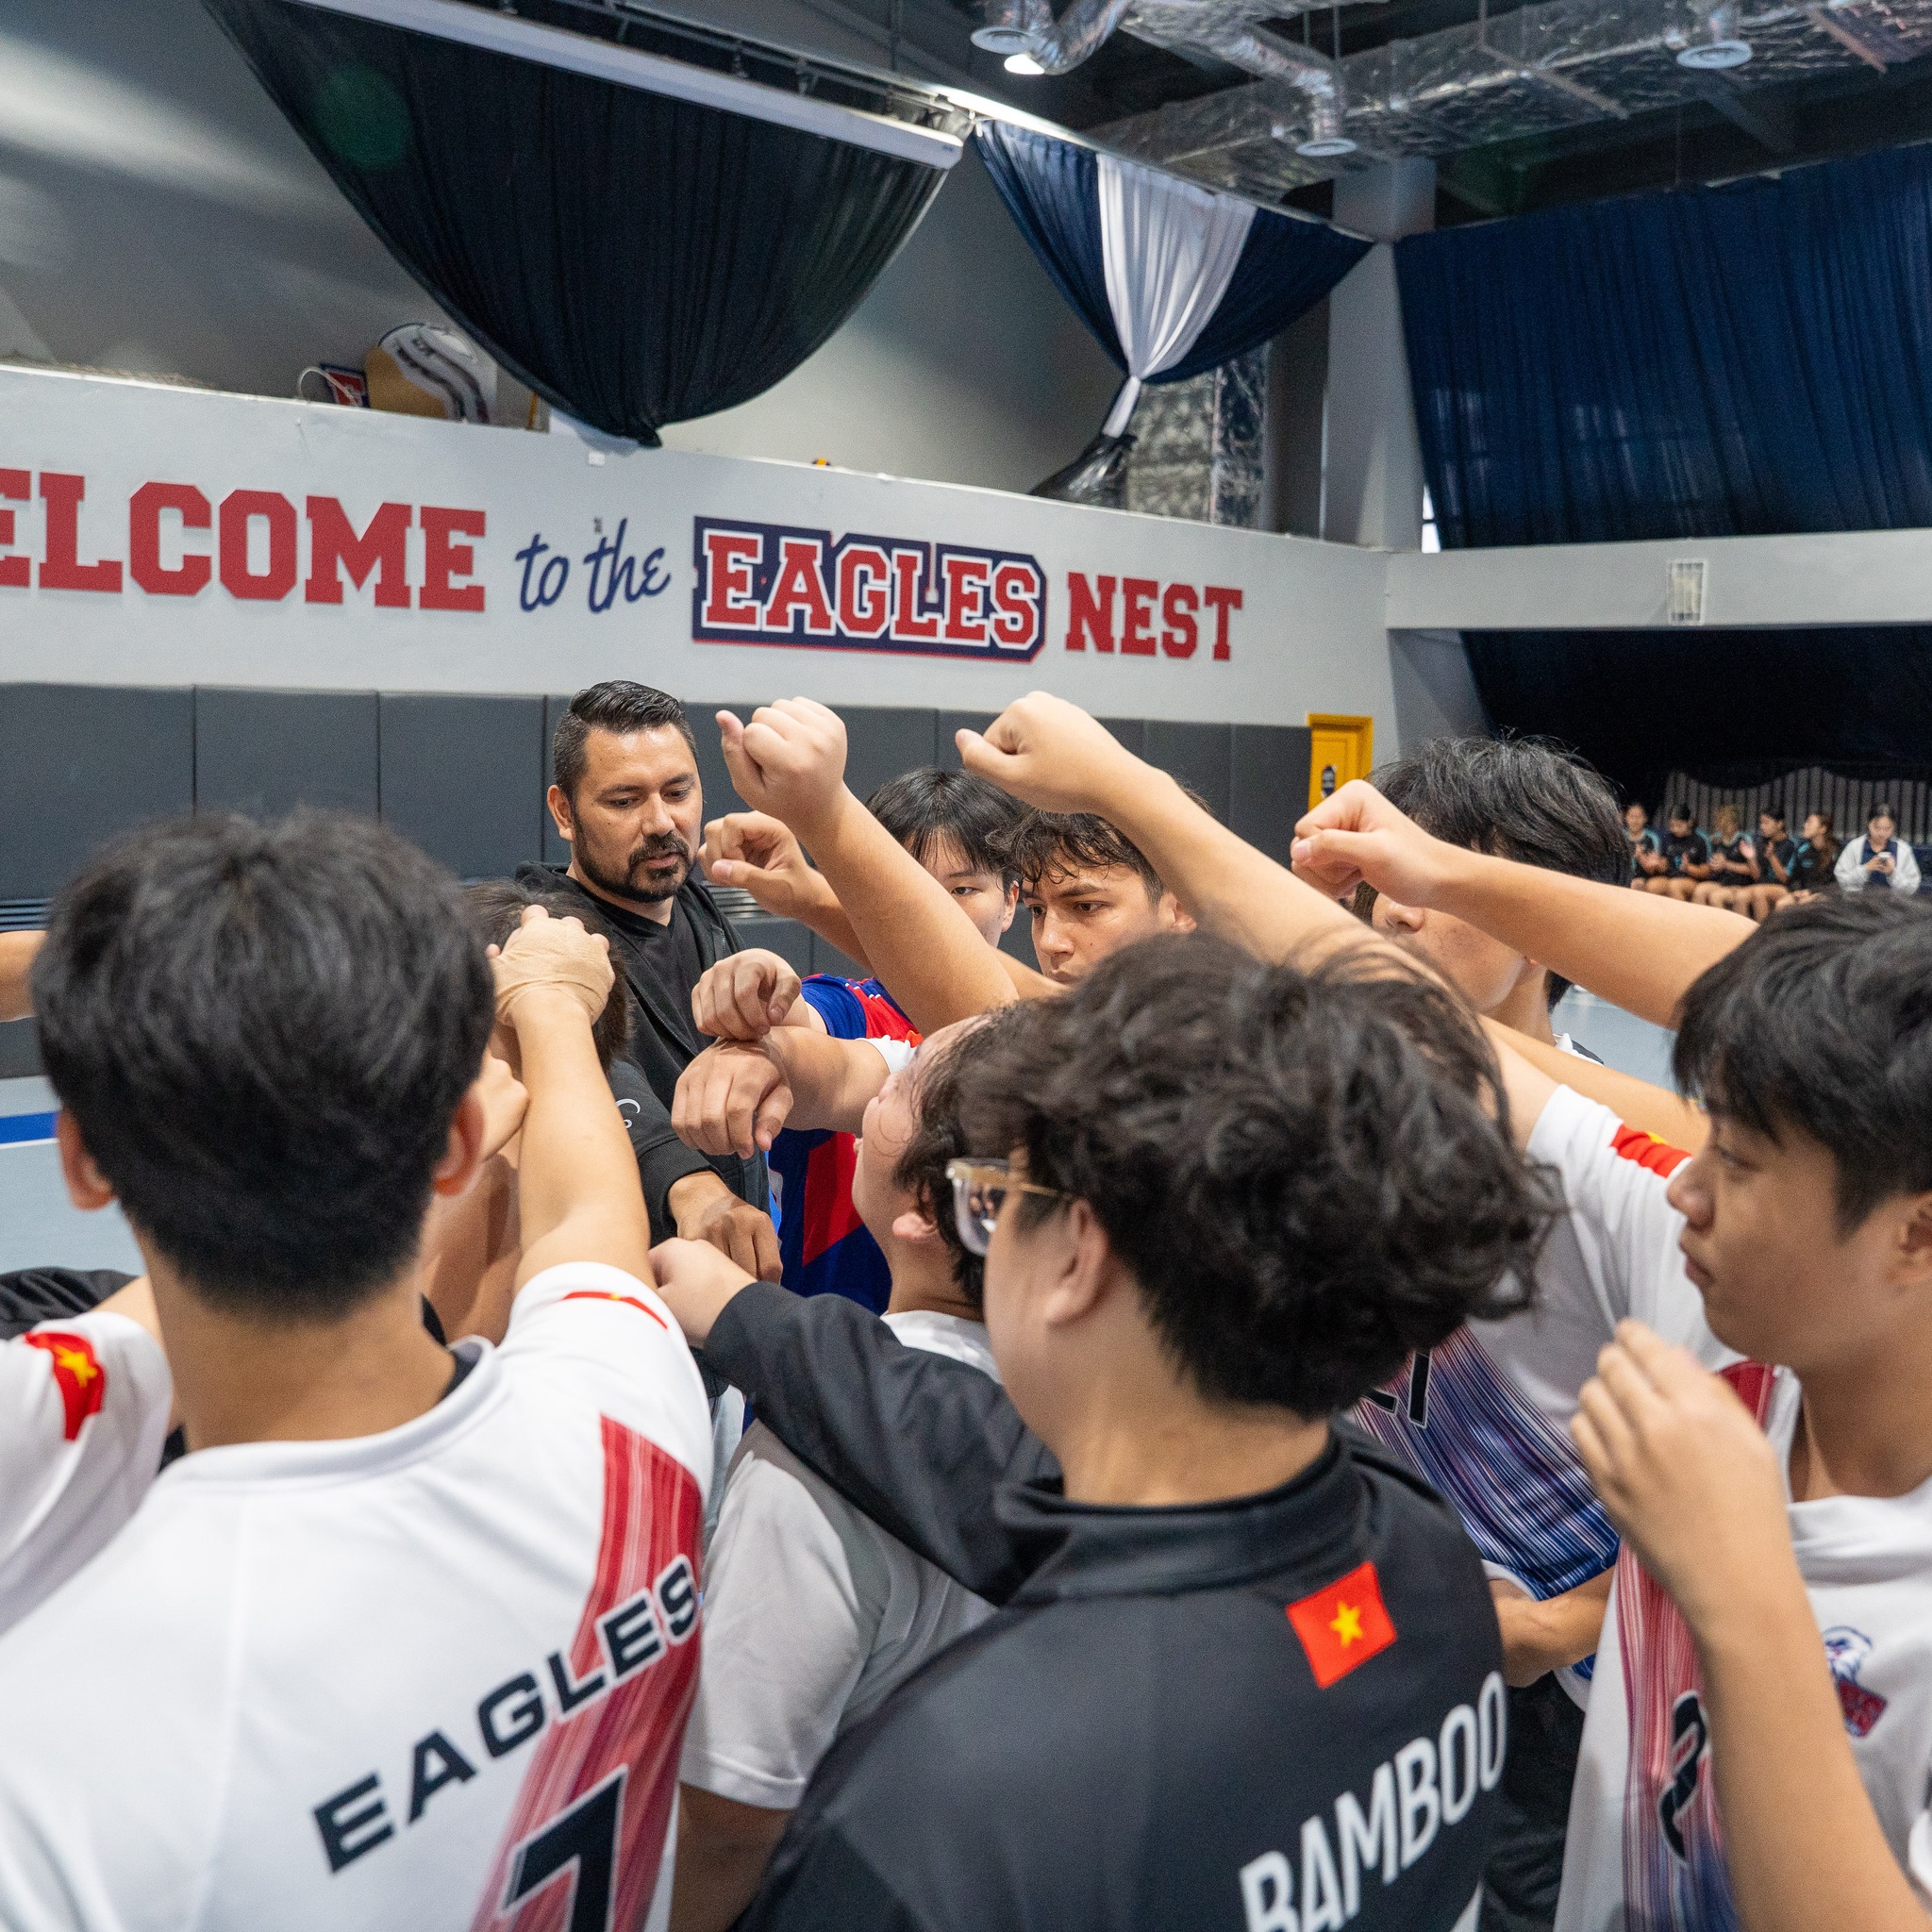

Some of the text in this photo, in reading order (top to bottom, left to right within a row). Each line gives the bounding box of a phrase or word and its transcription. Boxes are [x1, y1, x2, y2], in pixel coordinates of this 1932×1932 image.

[515, 533, 570, 612] to
[583, 518, 672, 614] the
[701, 528, 1042, 651] EAGLES
[1065, 571, 1243, 660] NEST
[312, 1555, 700, 1875] EAGLES
[1240, 1671, 1507, 1932] BAMBOO
